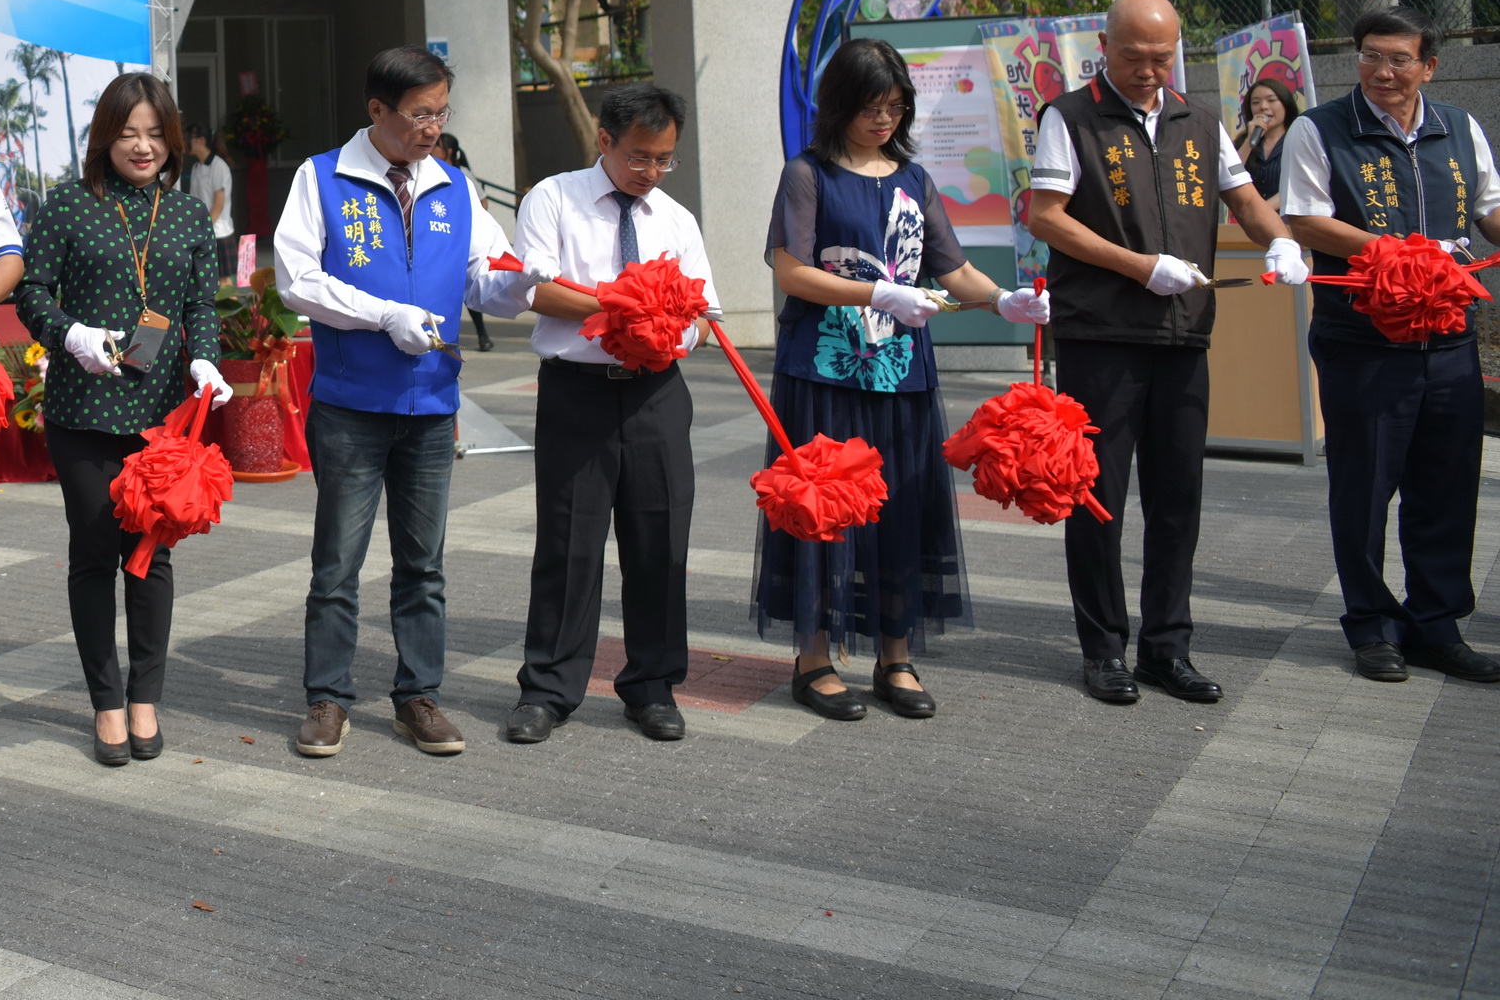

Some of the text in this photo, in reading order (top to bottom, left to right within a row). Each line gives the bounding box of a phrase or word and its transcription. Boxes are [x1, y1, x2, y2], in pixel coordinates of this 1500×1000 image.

[1123, 134, 1135, 158] 主任
[1185, 140, 1204, 207] 馬文君
[1105, 146, 1131, 206] 黃世榮
[1174, 159, 1189, 205] 服務團隊
[1360, 163, 1387, 227] 葉文心
[1379, 156, 1399, 207] 縣政顧問
[1448, 158, 1467, 229] 南投縣政府
[341, 198, 371, 267] 林明溱
[364, 191, 385, 249] 南投縣長
[429, 220, 451, 234] KMT
